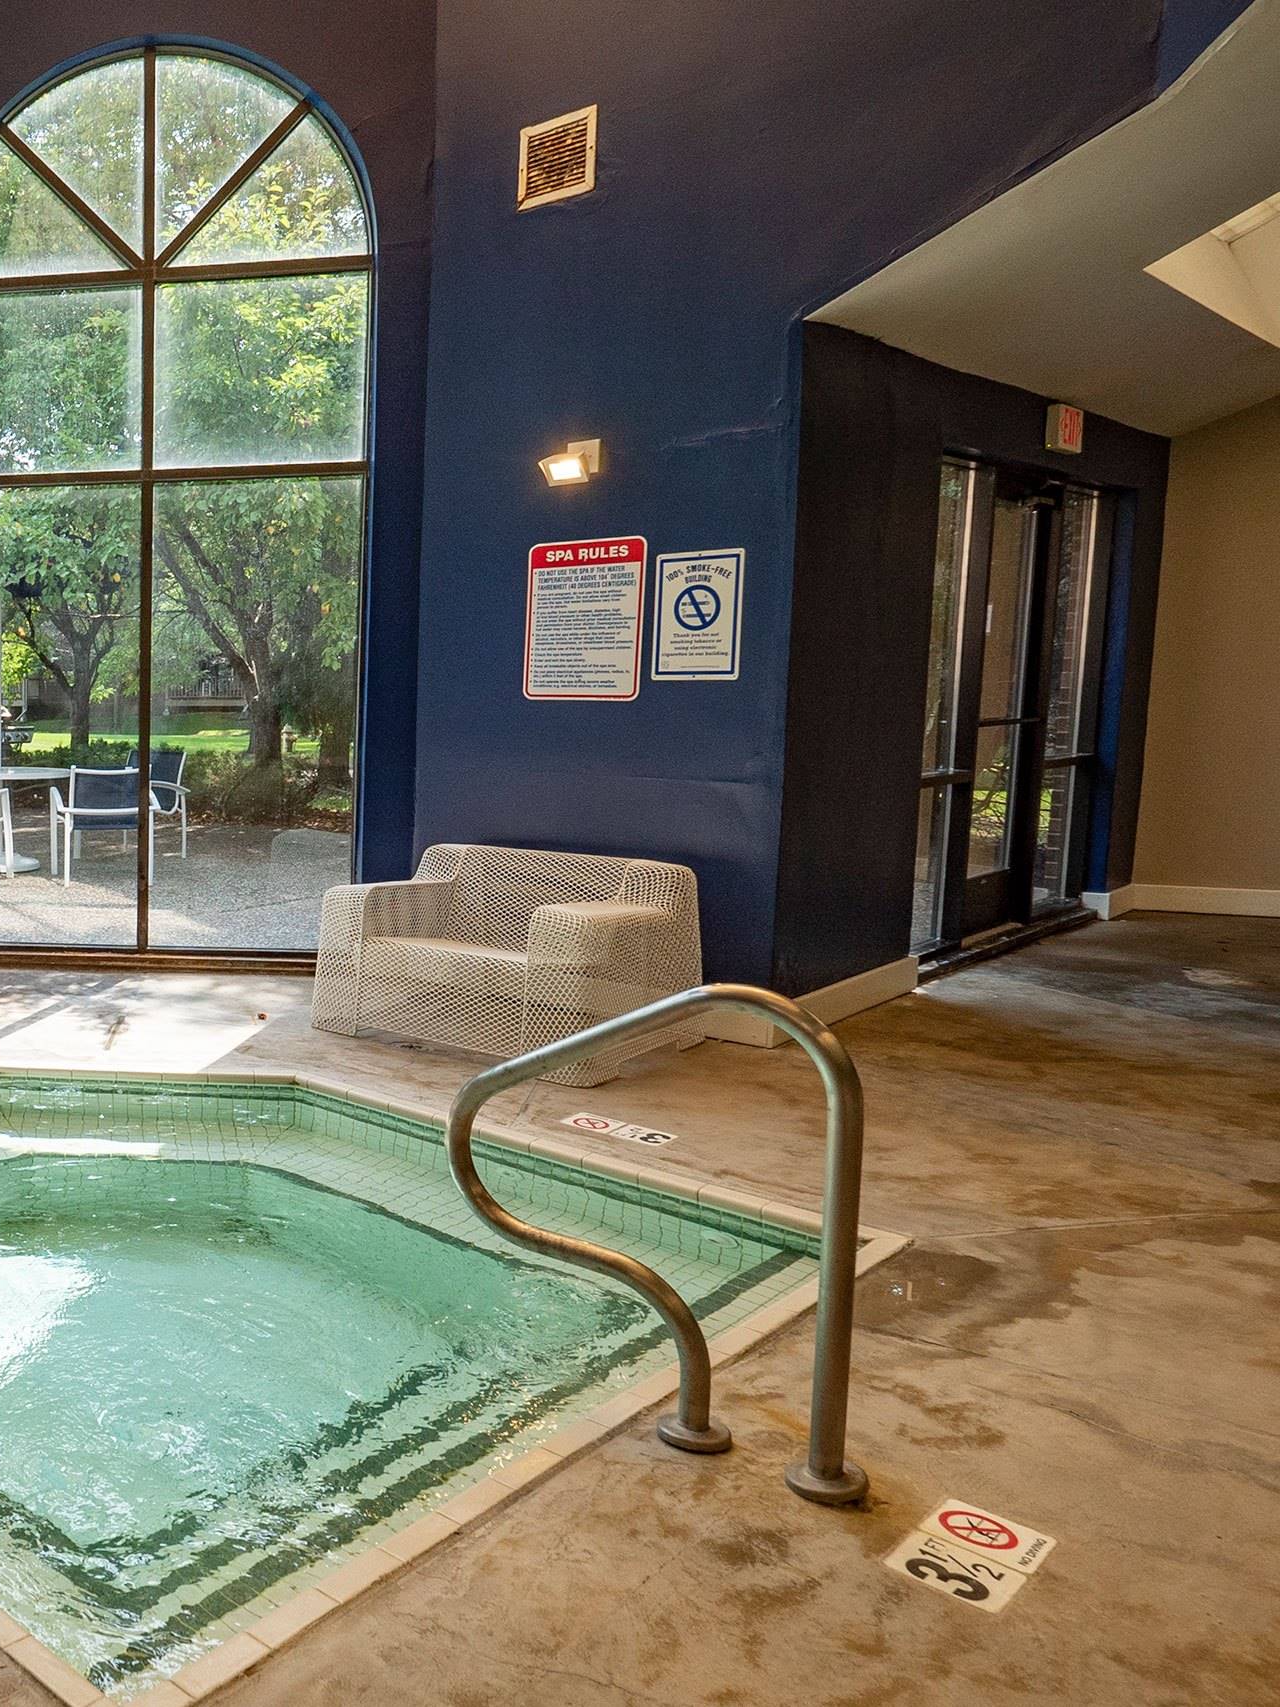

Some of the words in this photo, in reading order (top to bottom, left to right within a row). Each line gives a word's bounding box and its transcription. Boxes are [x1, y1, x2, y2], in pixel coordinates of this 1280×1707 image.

[545, 550, 574, 562] SPA
[579, 545, 629, 561] RULES
[666, 569, 684, 582] 100%
[686, 564, 733, 579] SMOKE-FREE
[685, 574, 712, 584] BUILDING
[578, 581, 600, 589] DEGREES
[640, 1133, 671, 1144] 3
[924, 1538, 945, 1551] FT
[1018, 1556, 1032, 1567] NO
[1026, 1538, 1047, 1558] DIVING
[905, 1558, 990, 1601] 3
